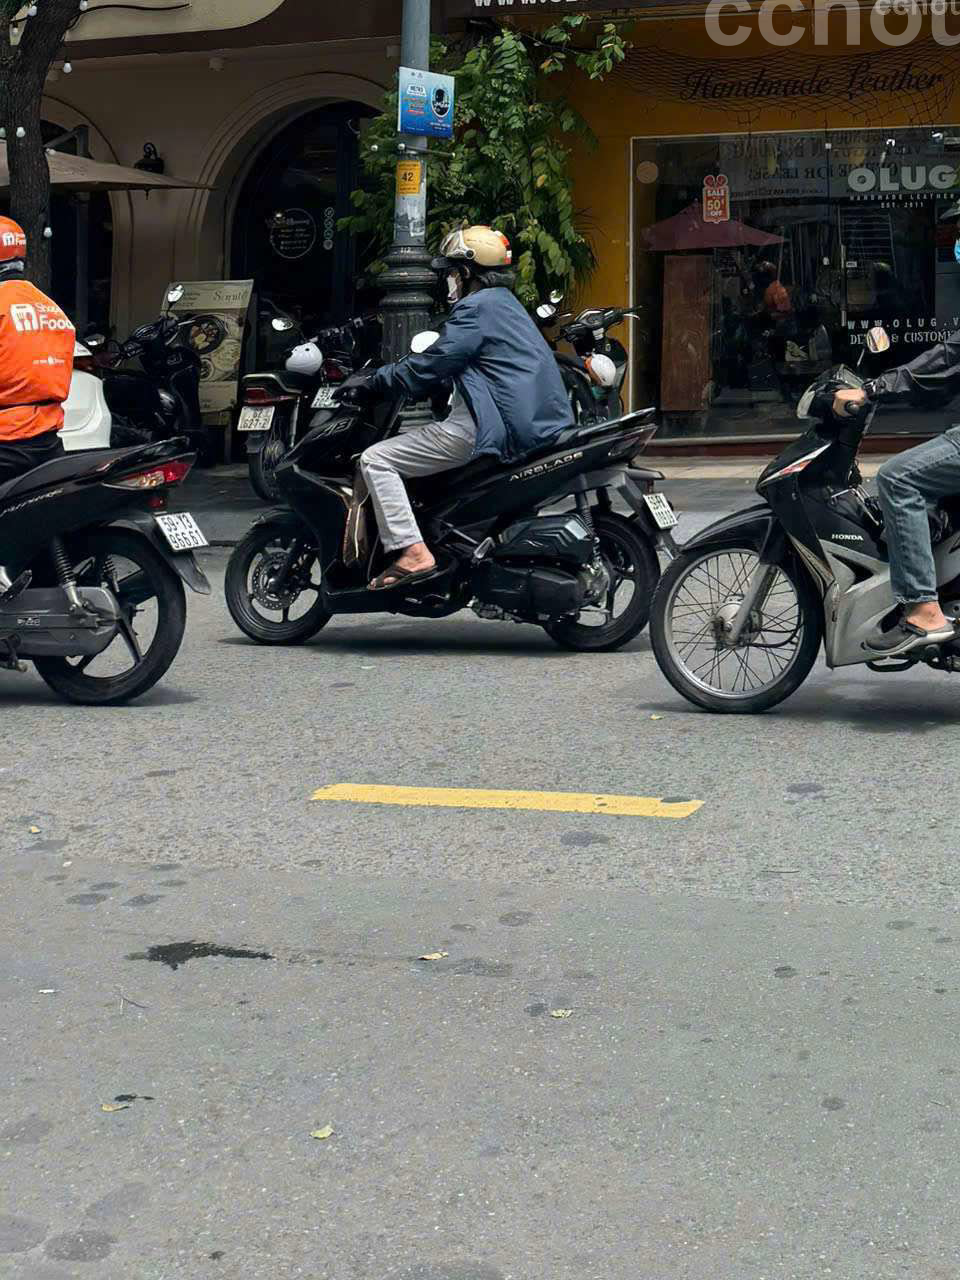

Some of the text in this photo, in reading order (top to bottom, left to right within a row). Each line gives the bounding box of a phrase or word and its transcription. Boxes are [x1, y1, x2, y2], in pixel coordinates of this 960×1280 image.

[680, 61, 945, 102] Handmade Leather
[401, 171, 414, 182] 42
[847, 164, 957, 193] OLUG
[850, 192, 955, 201] HANDMADE LEATHER
[831, 533, 864, 541] HONDA
